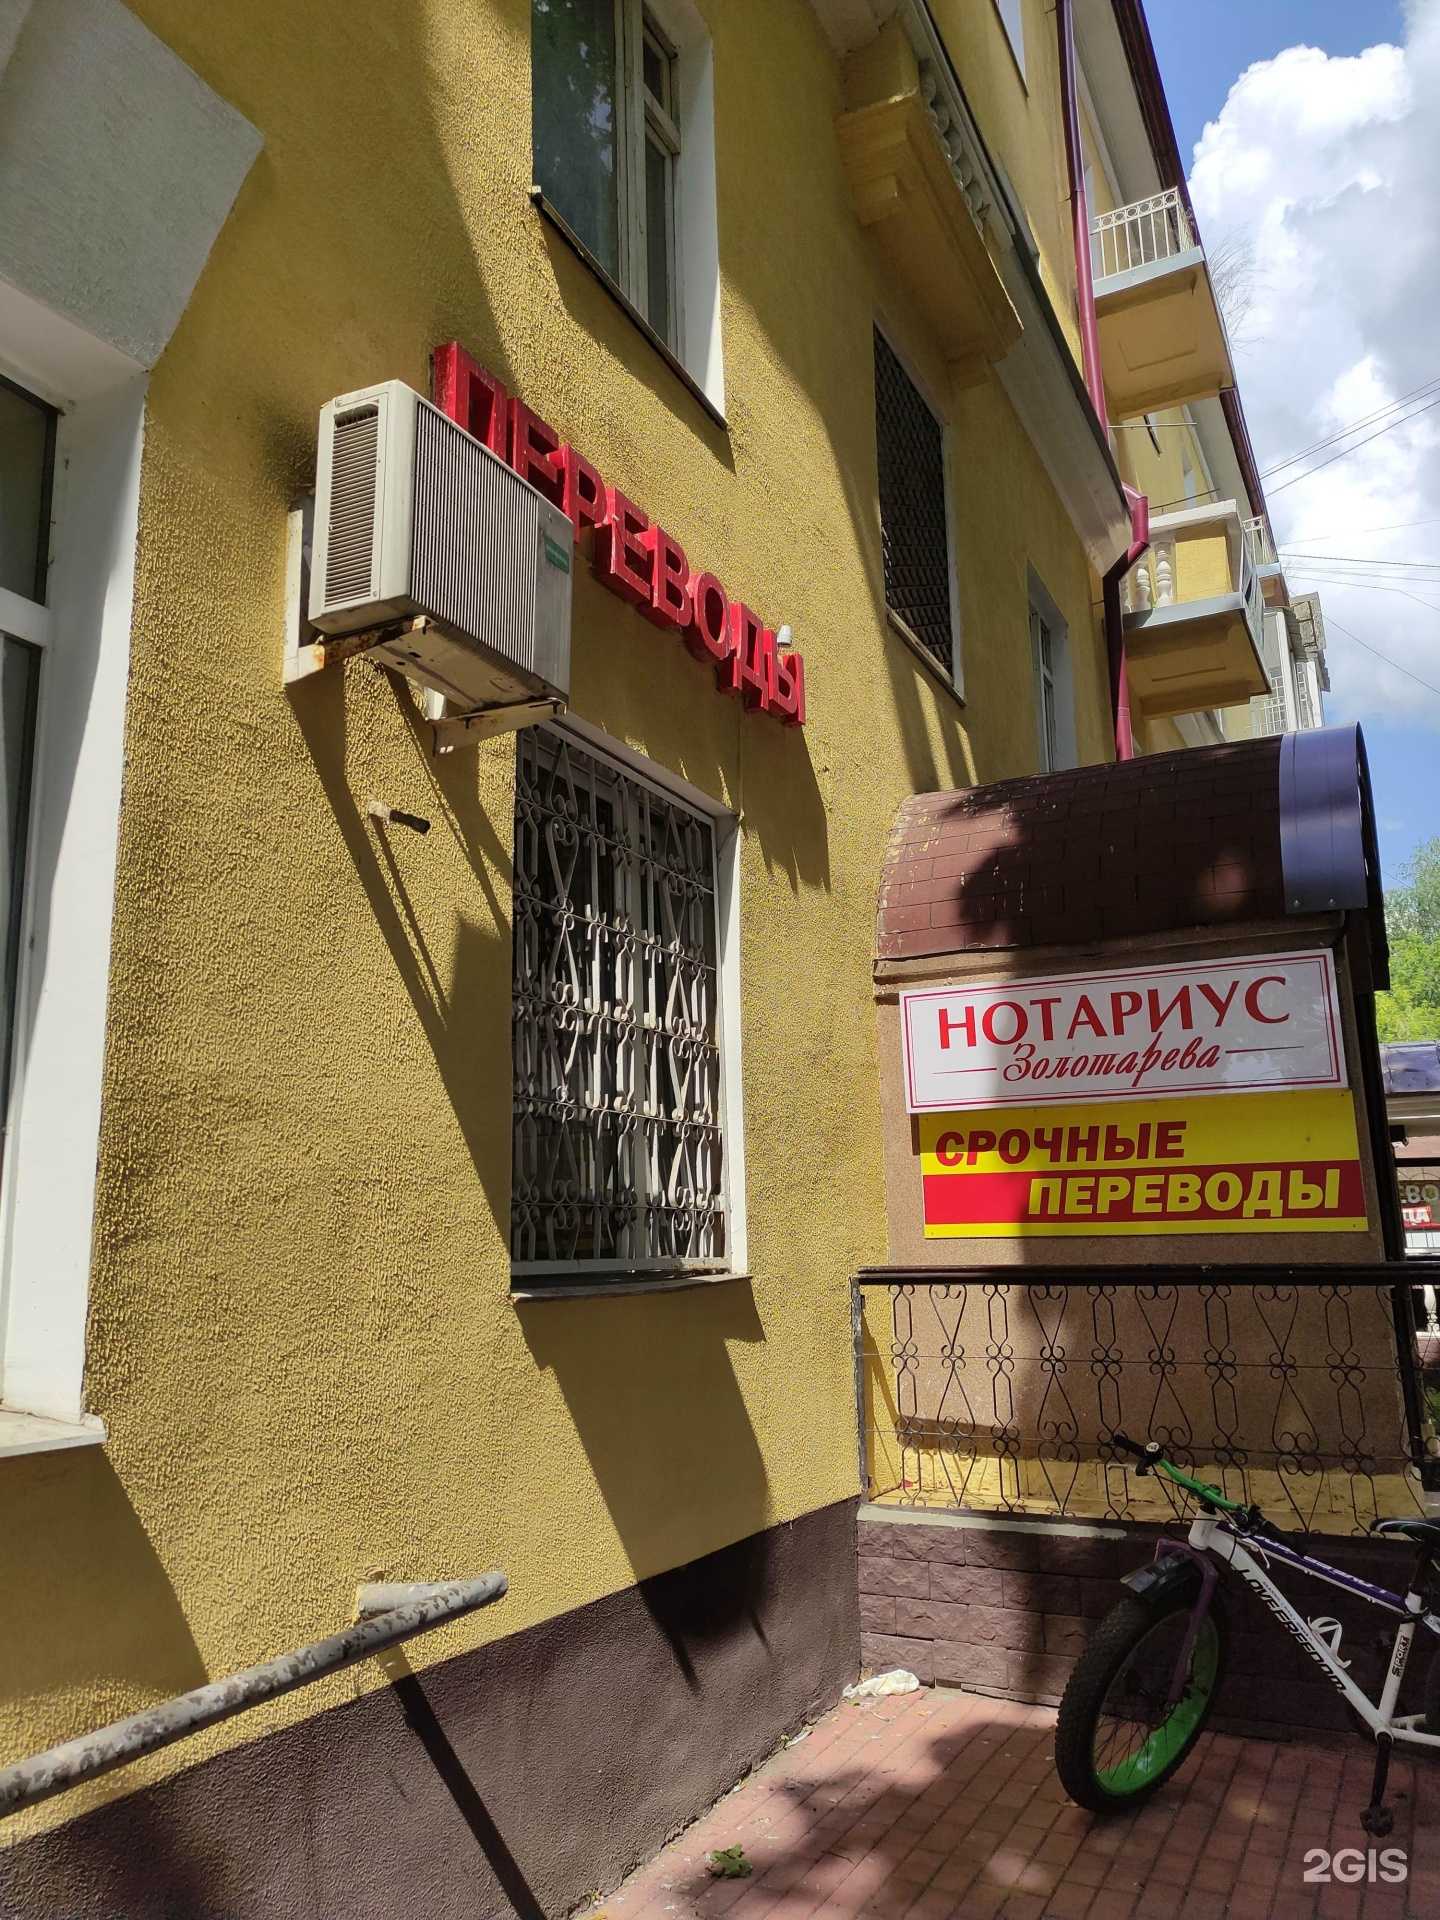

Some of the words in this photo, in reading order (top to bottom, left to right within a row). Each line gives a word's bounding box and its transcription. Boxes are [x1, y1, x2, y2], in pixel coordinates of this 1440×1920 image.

[432, 341, 805, 726] ПЕРЕВОДЫ
[938, 975, 1290, 1050] НОТАРИУС
[1003, 1031, 1222, 1088] Золотарева
[935, 1121, 1187, 1166] СРОЧНЫЕ
[1028, 1168, 1341, 1218] ПЕРЕВОДЫ
